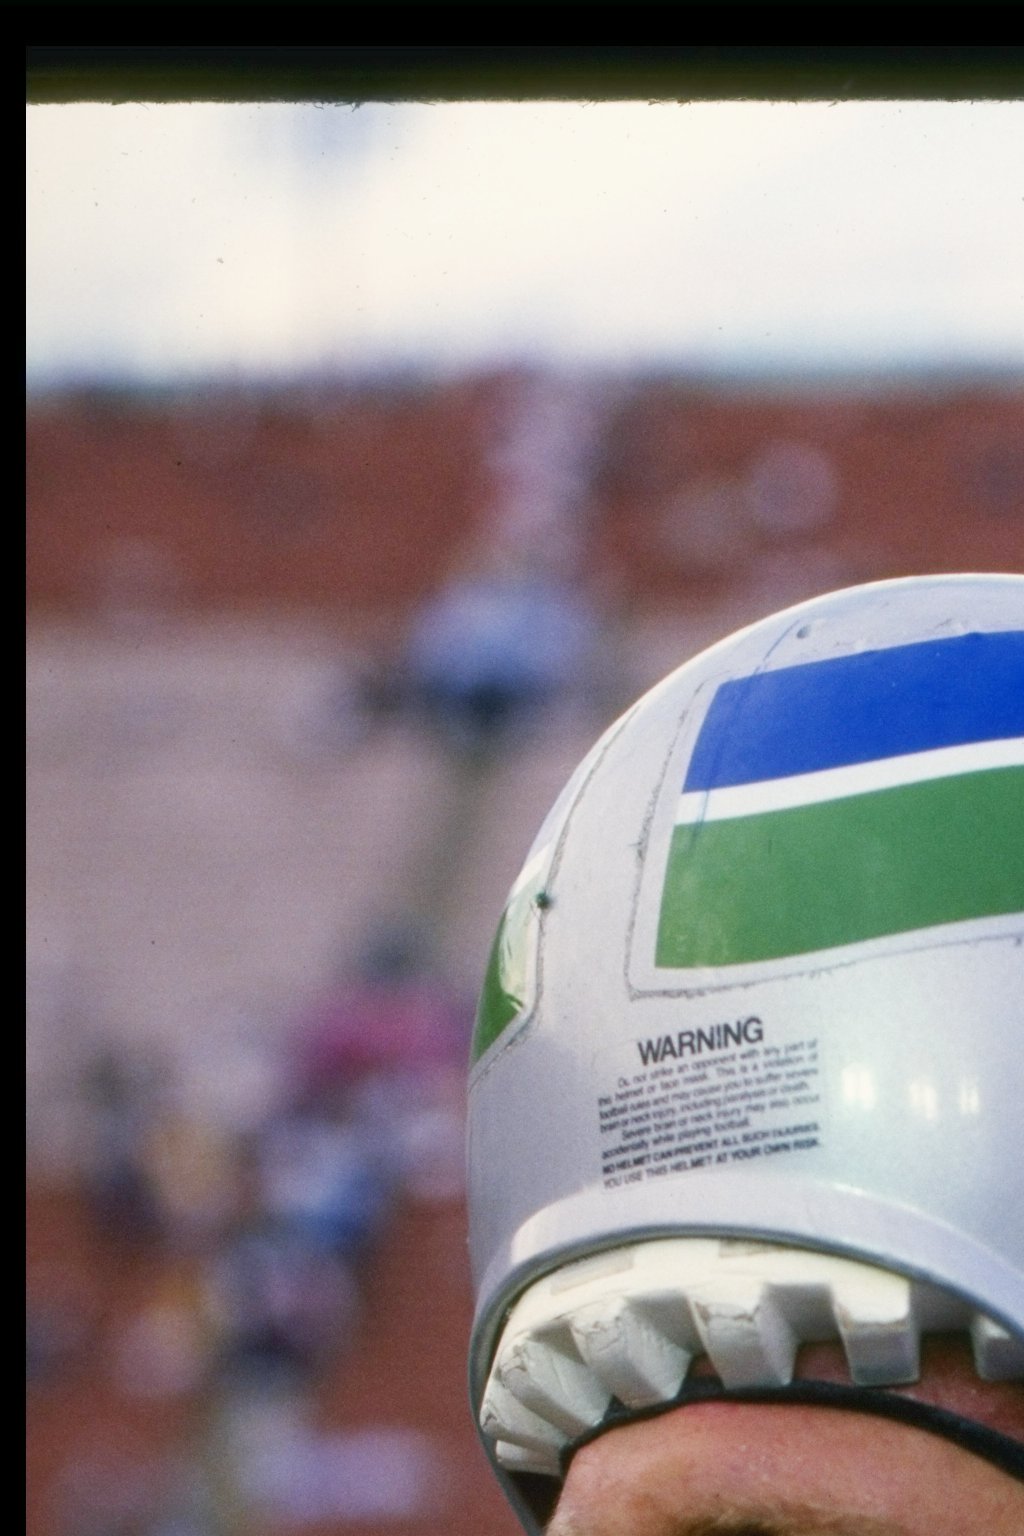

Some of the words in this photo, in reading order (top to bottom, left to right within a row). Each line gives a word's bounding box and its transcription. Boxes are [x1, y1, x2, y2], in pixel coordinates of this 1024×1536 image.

[633, 1074, 646, 1084] not
[650, 1068, 673, 1080] strike
[677, 1064, 688, 1073] an
[692, 1054, 736, 1071] opponent
[740, 1049, 759, 1060] with
[763, 1047, 780, 1057] any
[785, 1041, 805, 1053] part
[808, 1038, 817, 1049] of
[638, 1016, 763, 1066] WARNING
[599, 1104, 628, 1120] football
[630, 1100, 650, 1111] rules
[653, 1095, 669, 1105] and
[672, 1092, 690, 1101] may
[694, 1085, 721, 1097] cause
[724, 1081, 741, 1092] you
[744, 1078, 752, 1086] to
[755, 1072, 782, 1085] suffer
[615, 1087, 643, 1101] helmet
[647, 1085, 656, 1093] or
[660, 1080, 679, 1091] face
[716, 1067, 736, 1077] This
[763, 1056, 804, 1068] violation
[808, 1053, 818, 1061] of
[600, 1121, 620, 1133] brain
[621, 1119, 629, 1127] or
[631, 1112, 650, 1123] neck
[680, 1098, 721, 1112] including
[723, 1091, 766, 1104] paralysis
[622, 1127, 651, 1141] Severe
[654, 1120, 676, 1131] brain
[678, 1117, 688, 1126] or
[691, 1112, 713, 1122] neck
[716, 1108, 741, 1118] injury
[745, 1103, 765, 1112] may
[770, 1099, 789, 1109] also
[792, 1095, 819, 1104] occur
[603, 1164, 615, 1174] NO
[616, 1154, 651, 1170] HELMET
[653, 1150, 672, 1162] CAN
[674, 1139, 718, 1156] PREVENT
[722, 1136, 739, 1146] ALL
[742, 1131, 770, 1142] SUCH
[652, 1134, 674, 1145] while
[678, 1126, 711, 1142] playing
[604, 1176, 621, 1188] YOU
[624, 1170, 642, 1184] USE
[646, 1165, 667, 1176] THIS
[671, 1155, 712, 1172] HELMET
[716, 1152, 727, 1163] AT
[731, 1146, 761, 1160] YOUR
[764, 1142, 790, 1154] OWN
